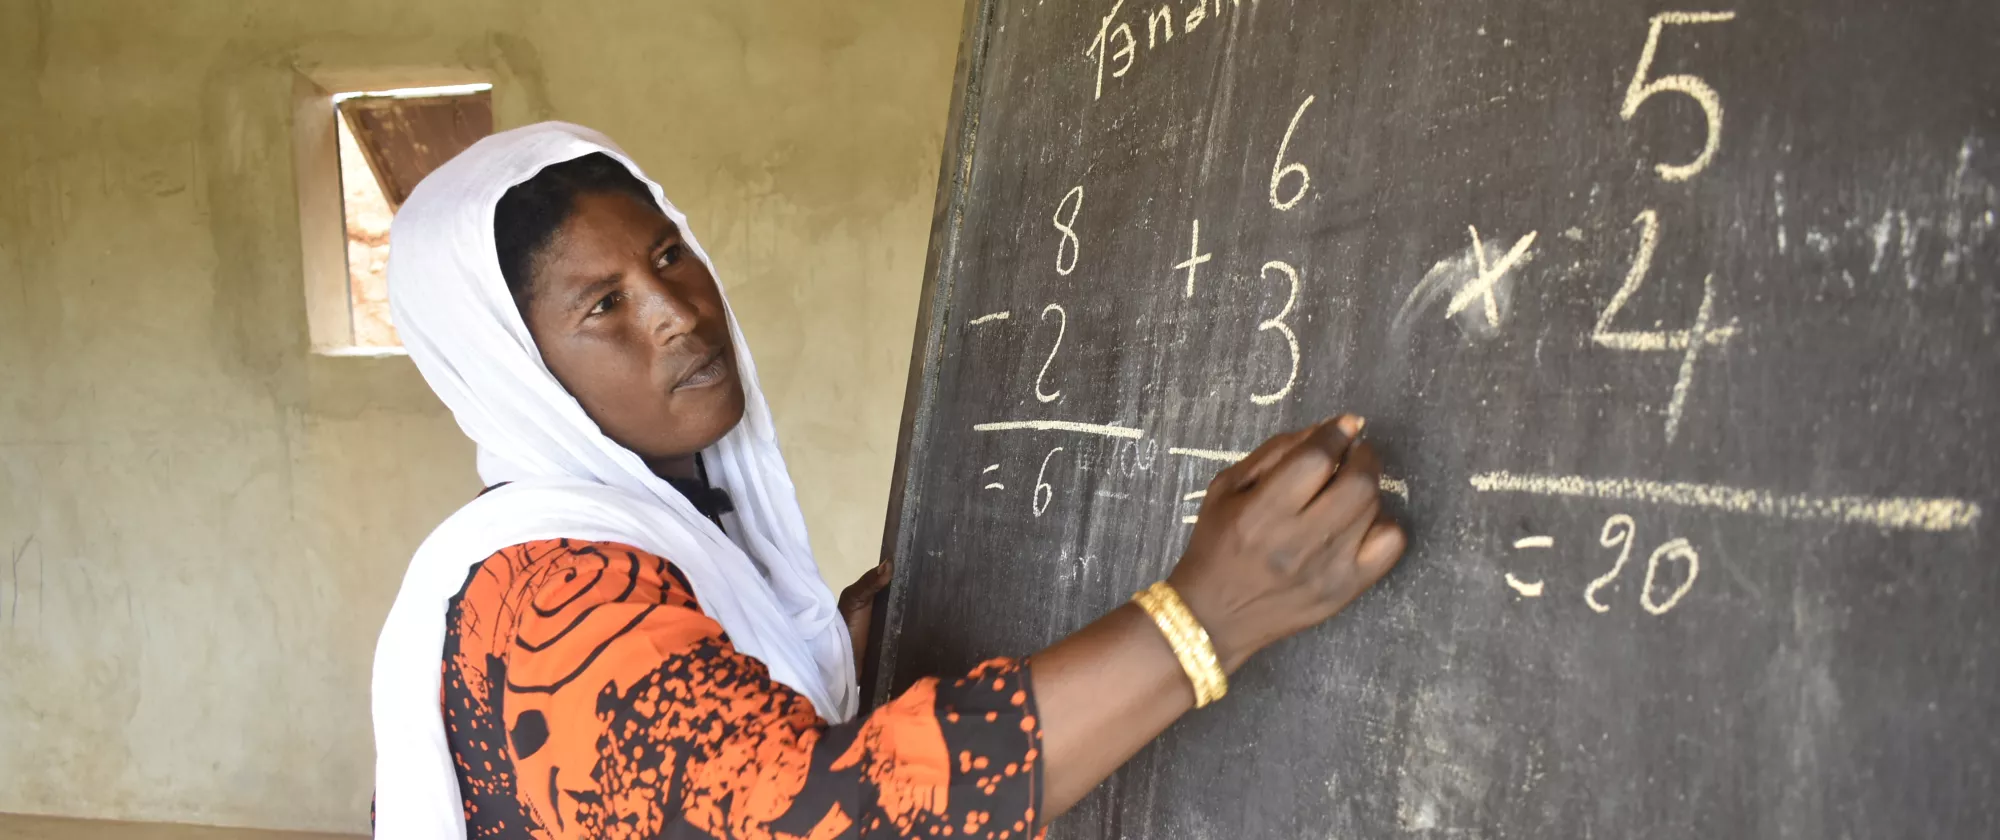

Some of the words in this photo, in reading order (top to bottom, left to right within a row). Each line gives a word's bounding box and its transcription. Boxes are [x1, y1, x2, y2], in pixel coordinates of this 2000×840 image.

[1620, 11, 1735, 182] 5
[1269, 95, 1314, 211] 6
[1053, 186, 1083, 276] 8
[1035, 303, 1066, 403] 2
[1249, 260, 1300, 405] 3
[1593, 209, 1742, 443] 4
[1033, 447, 1063, 517] 6
[1585, 513, 1700, 615] 20
